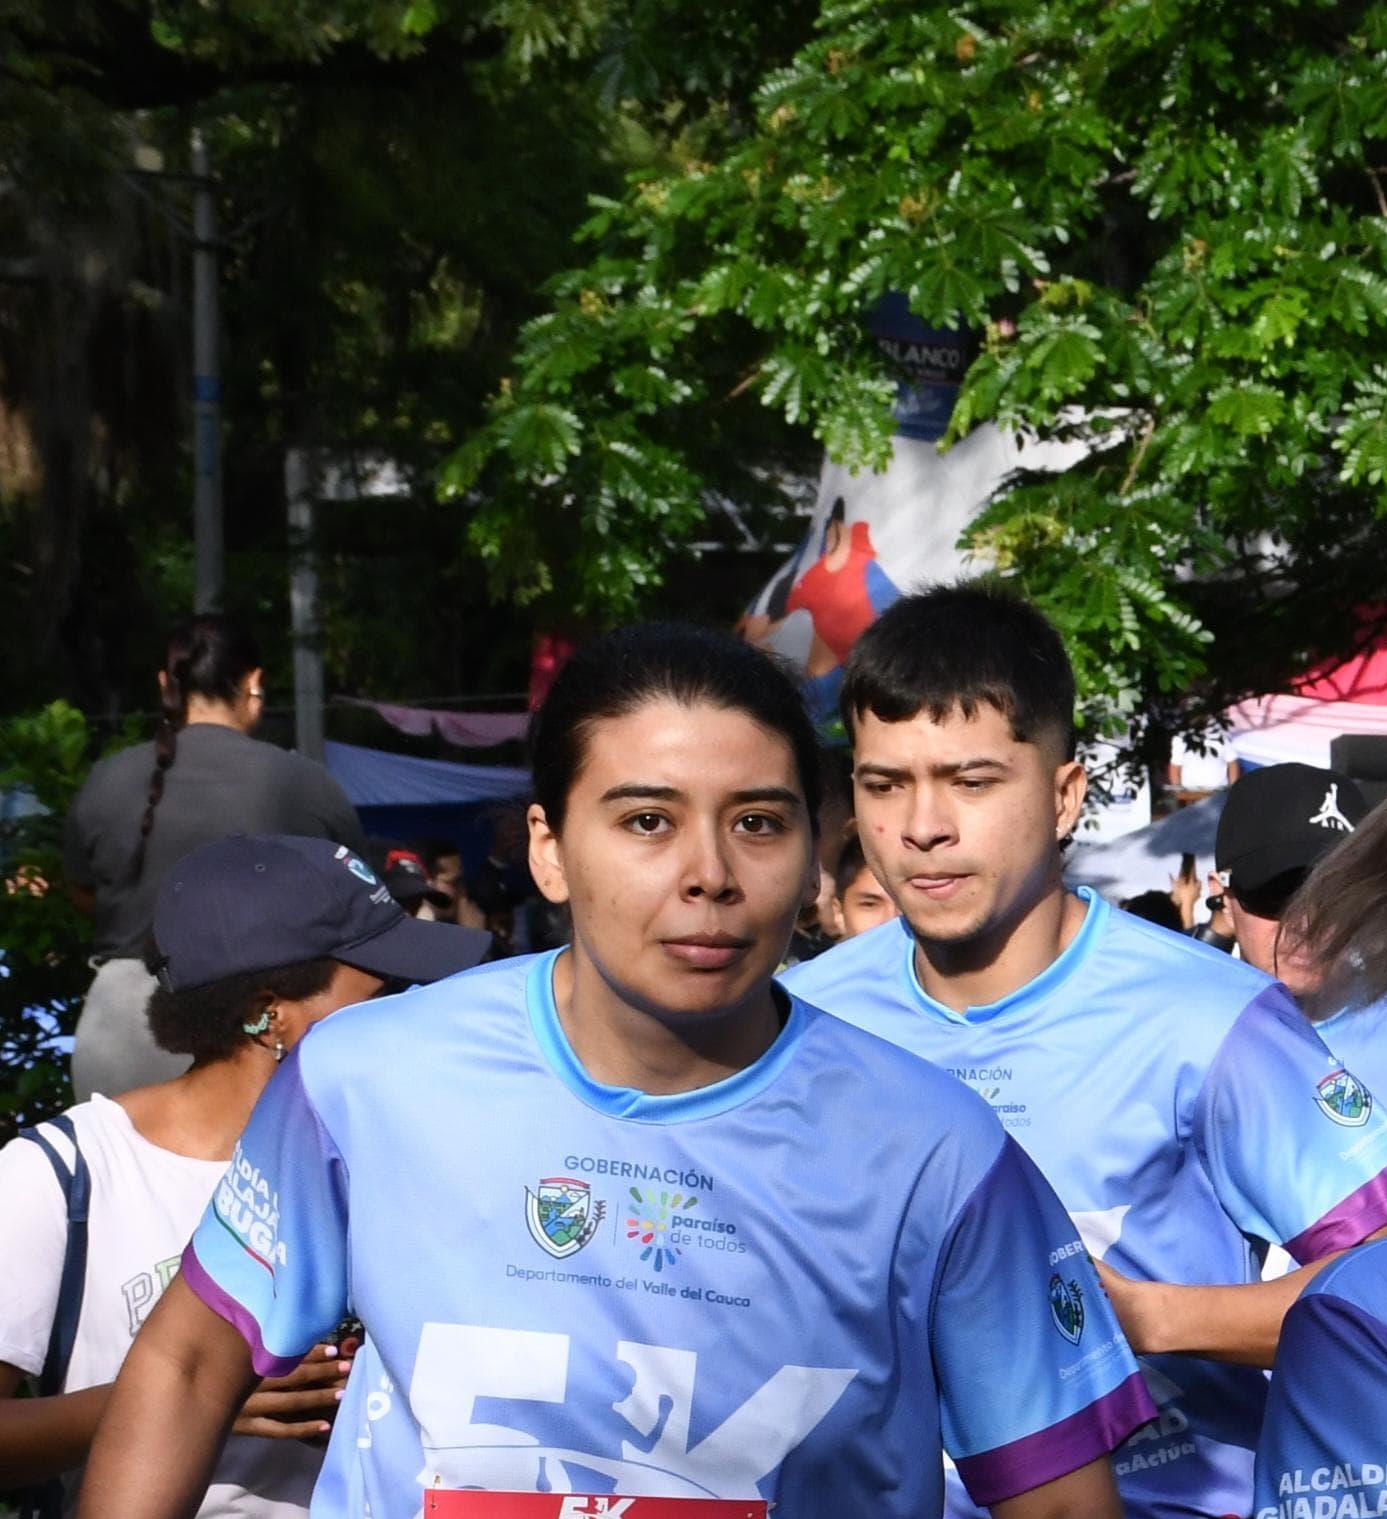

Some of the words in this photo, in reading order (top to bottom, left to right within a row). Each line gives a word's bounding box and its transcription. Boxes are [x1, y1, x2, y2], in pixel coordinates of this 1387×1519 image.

[564, 1154, 714, 1192] GOBERNACIÓN
[216, 1181, 287, 1266] BUGA
[670, 1228, 692, 1246] de
[698, 1233, 747, 1254] todos
[671, 1213, 737, 1236] paraíso
[506, 1263, 612, 1289] Departamento
[615, 1276, 638, 1291] del
[642, 1279, 677, 1298] Valle
[680, 1285, 702, 1301] del
[705, 1289, 751, 1308] Cauca
